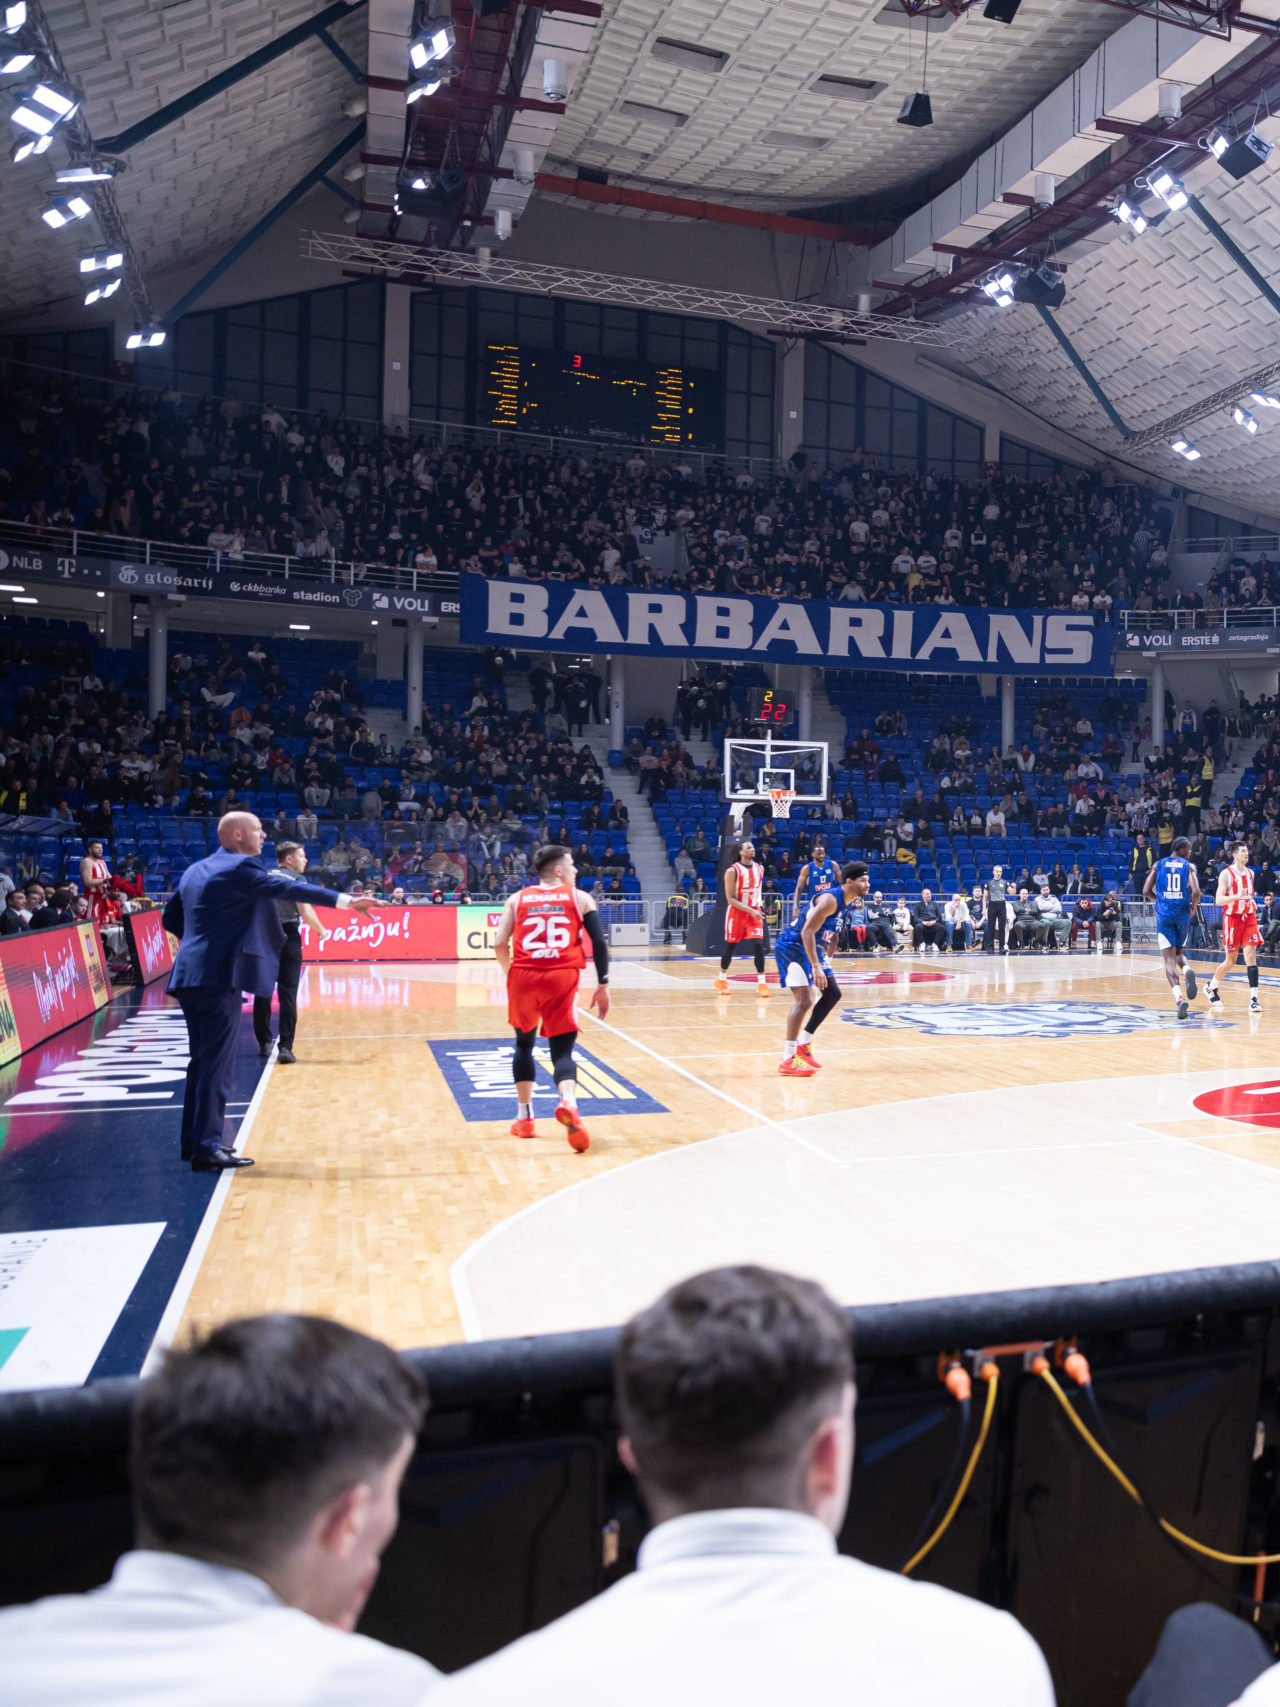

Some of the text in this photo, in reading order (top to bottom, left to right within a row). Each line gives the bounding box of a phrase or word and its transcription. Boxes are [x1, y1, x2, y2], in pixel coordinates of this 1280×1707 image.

[573, 355, 581, 368] 3
[12, 555, 43, 571] NLB
[144, 571, 214, 590] glosarij
[293, 590, 340, 603] stadion
[393, 596, 429, 612] VOLI
[485, 579, 1095, 664] BARBARIANS
[1143, 634, 1172, 646] VOLI
[1181, 635, 1211, 646] ERSTE
[764, 690, 773, 702] 2
[761, 703, 787, 720] 22
[1166, 873, 1182, 892] 10
[522, 915, 571, 951] 26
